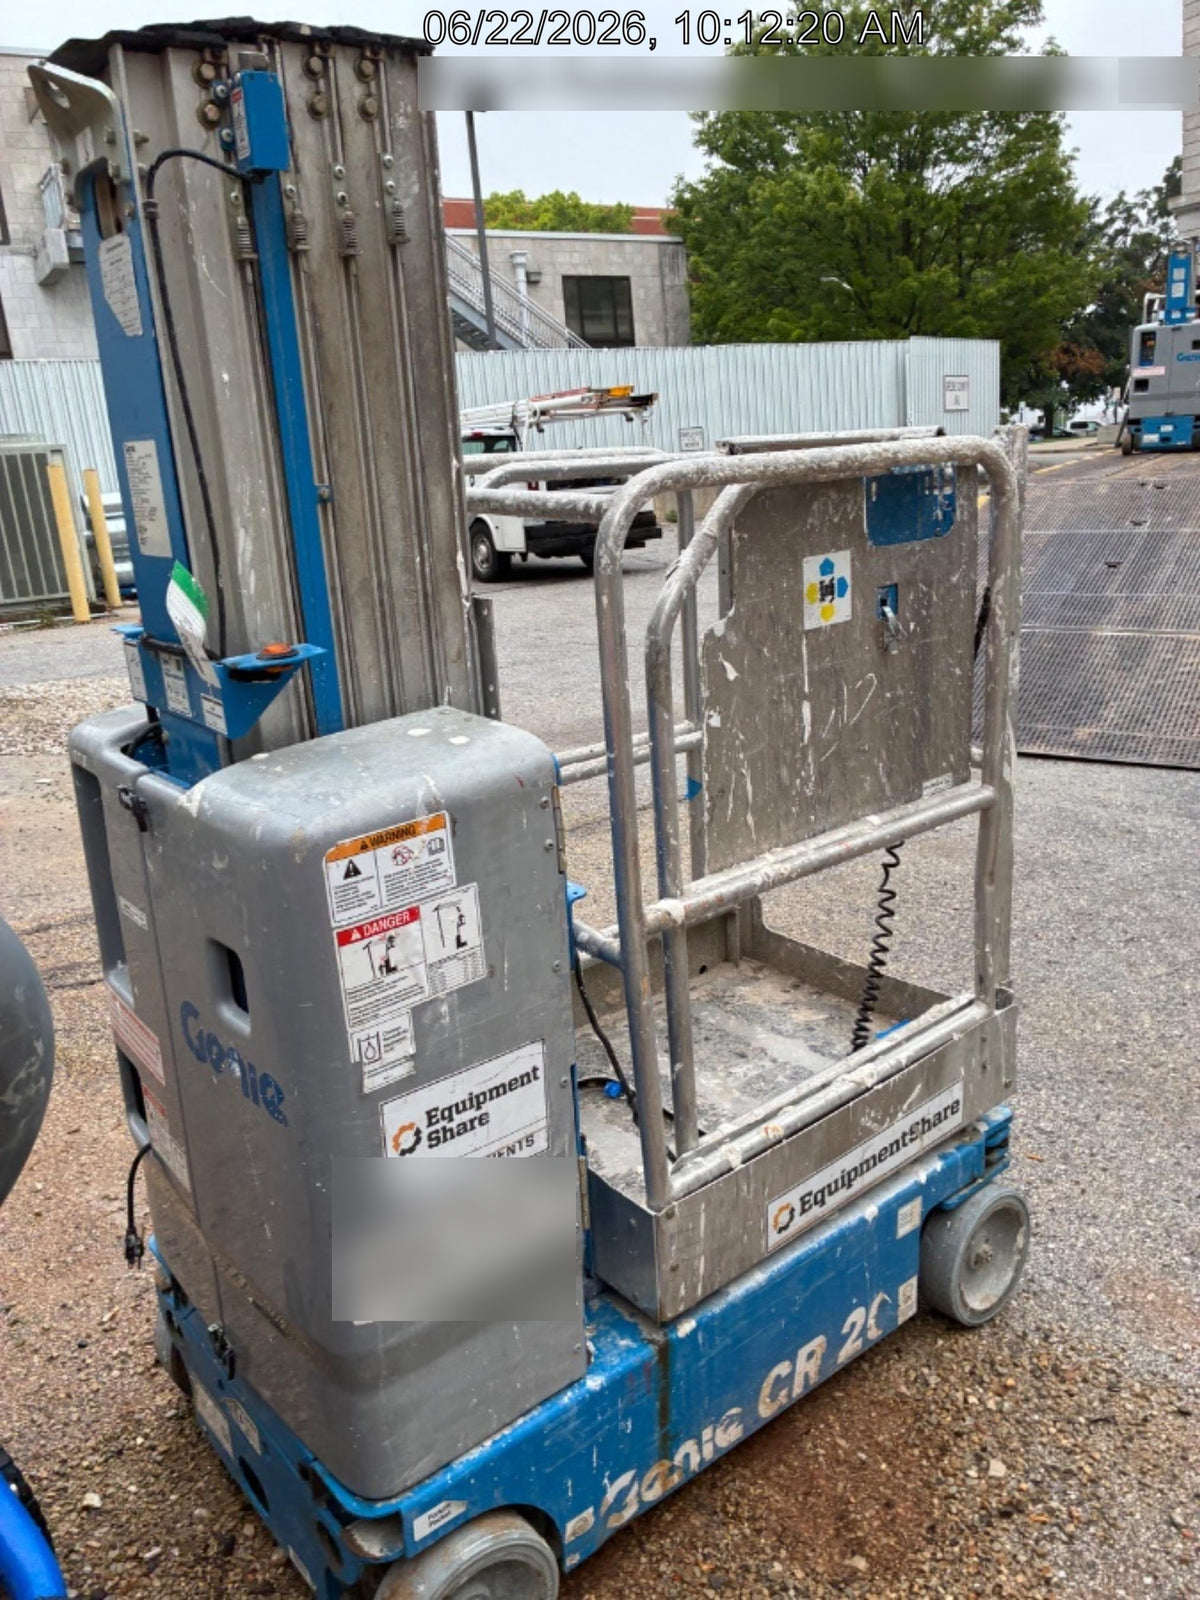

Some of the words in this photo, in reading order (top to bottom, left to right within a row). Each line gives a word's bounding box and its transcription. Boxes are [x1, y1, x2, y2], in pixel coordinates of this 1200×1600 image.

[369, 824, 416, 848] WARNING
[362, 911, 411, 937] DANGER
[181, 1000, 288, 1127] Genie
[425, 1064, 540, 1129] Equipment
[426, 1111, 490, 1150] Share
[799, 1098, 961, 1216] EquipmentShare
